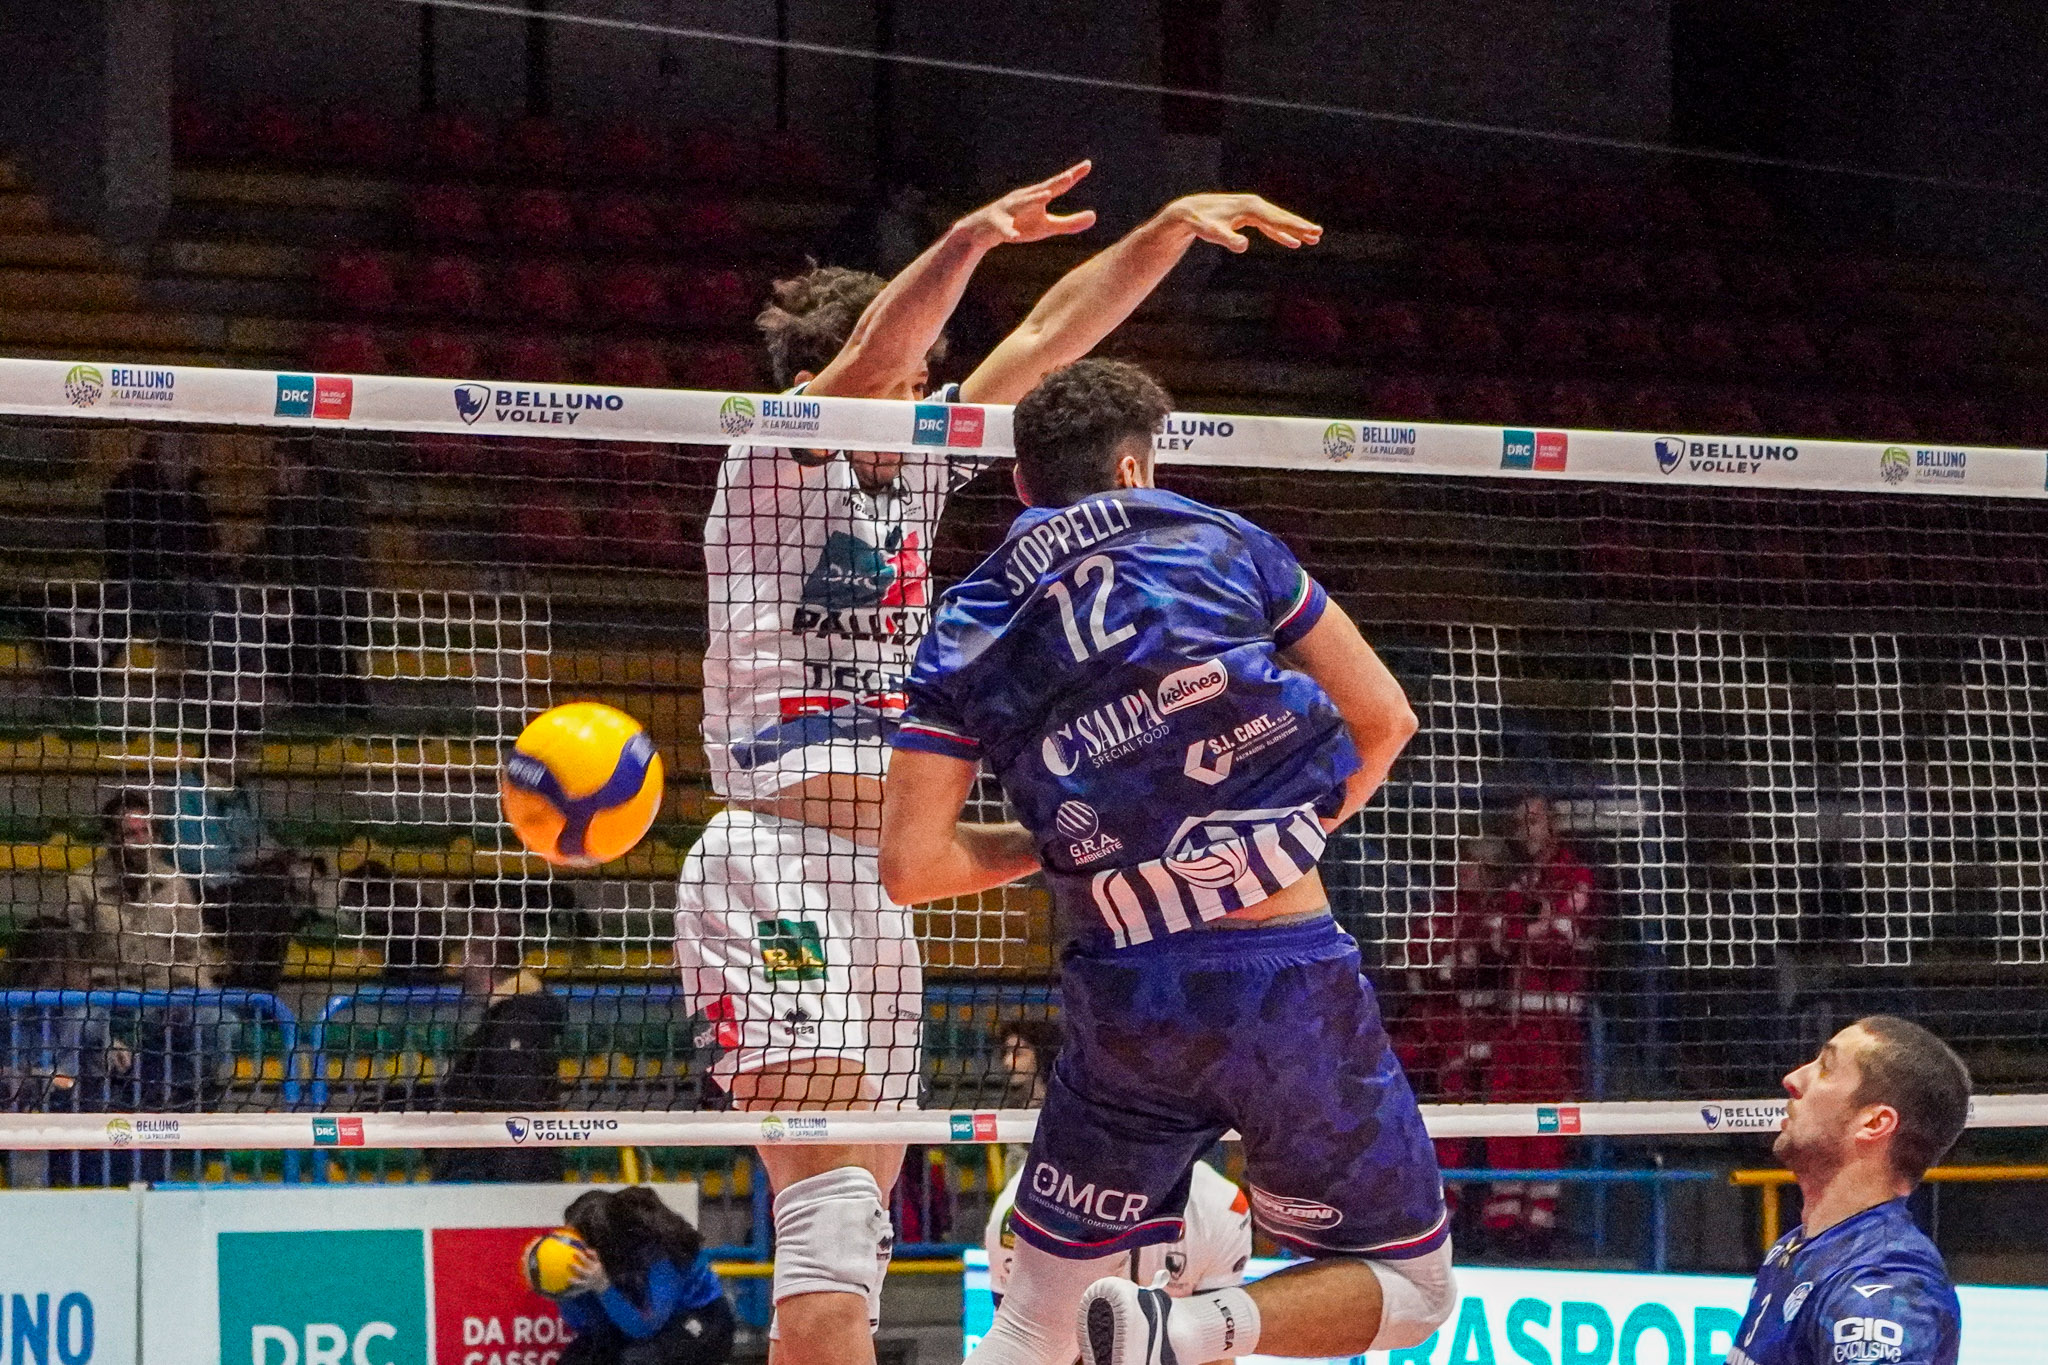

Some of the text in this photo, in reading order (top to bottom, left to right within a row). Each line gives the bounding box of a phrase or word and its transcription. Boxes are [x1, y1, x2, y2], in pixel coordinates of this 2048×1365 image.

[111, 369, 175, 389] BELLUNO
[120, 389, 130, 399] LA
[132, 390, 174, 401] PALLAVOLO
[281, 389, 310, 403] DRC
[495, 390, 624, 411] BELLUNO
[495, 409, 580, 425] VOLLEY
[762, 400, 820, 419] BELLUNO
[918, 418, 945, 432] DRC
[1159, 420, 1234, 438] LUNO
[1157, 437, 1195, 451] LEY
[1362, 426, 1417, 445] BELLUNO
[1506, 444, 1531, 456] DRC
[1689, 442, 1799, 461] BELLUNO
[1916, 450, 1967, 468] BELLUNO
[1689, 460, 1762, 475] VOLLEY
[1004, 498, 1132, 597] STOPPELLI
[1043, 554, 1138, 663] 12
[1076, 688, 1166, 758] SALPA
[1207, 734, 1236, 755] S.I.
[1233, 713, 1277, 743] CART.
[1092, 724, 1170, 769] SPECIAL FOOD
[1069, 833, 1119, 858] G.R.A.
[1074, 840, 1124, 866] AMBIENTE
[1724, 1106, 1786, 1118] BELLUN
[136, 1120, 180, 1132] BELLUNO
[532, 1119, 619, 1130] BELLUNO
[788, 1117, 827, 1129] BELLUNO
[1726, 1118, 1774, 1127] VOLLEY
[535, 1131, 592, 1141] VOLLEY
[1032, 1162, 1149, 1222] OMCR
[0, 1291, 95, 1365] NO
[462, 1315, 579, 1346] DA ROL
[1211, 1298, 1236, 1352] LEGEA
[1388, 1295, 1744, 1365] ASPO
[1833, 1316, 1904, 1347] GIO
[251, 1320, 398, 1365] DRC
